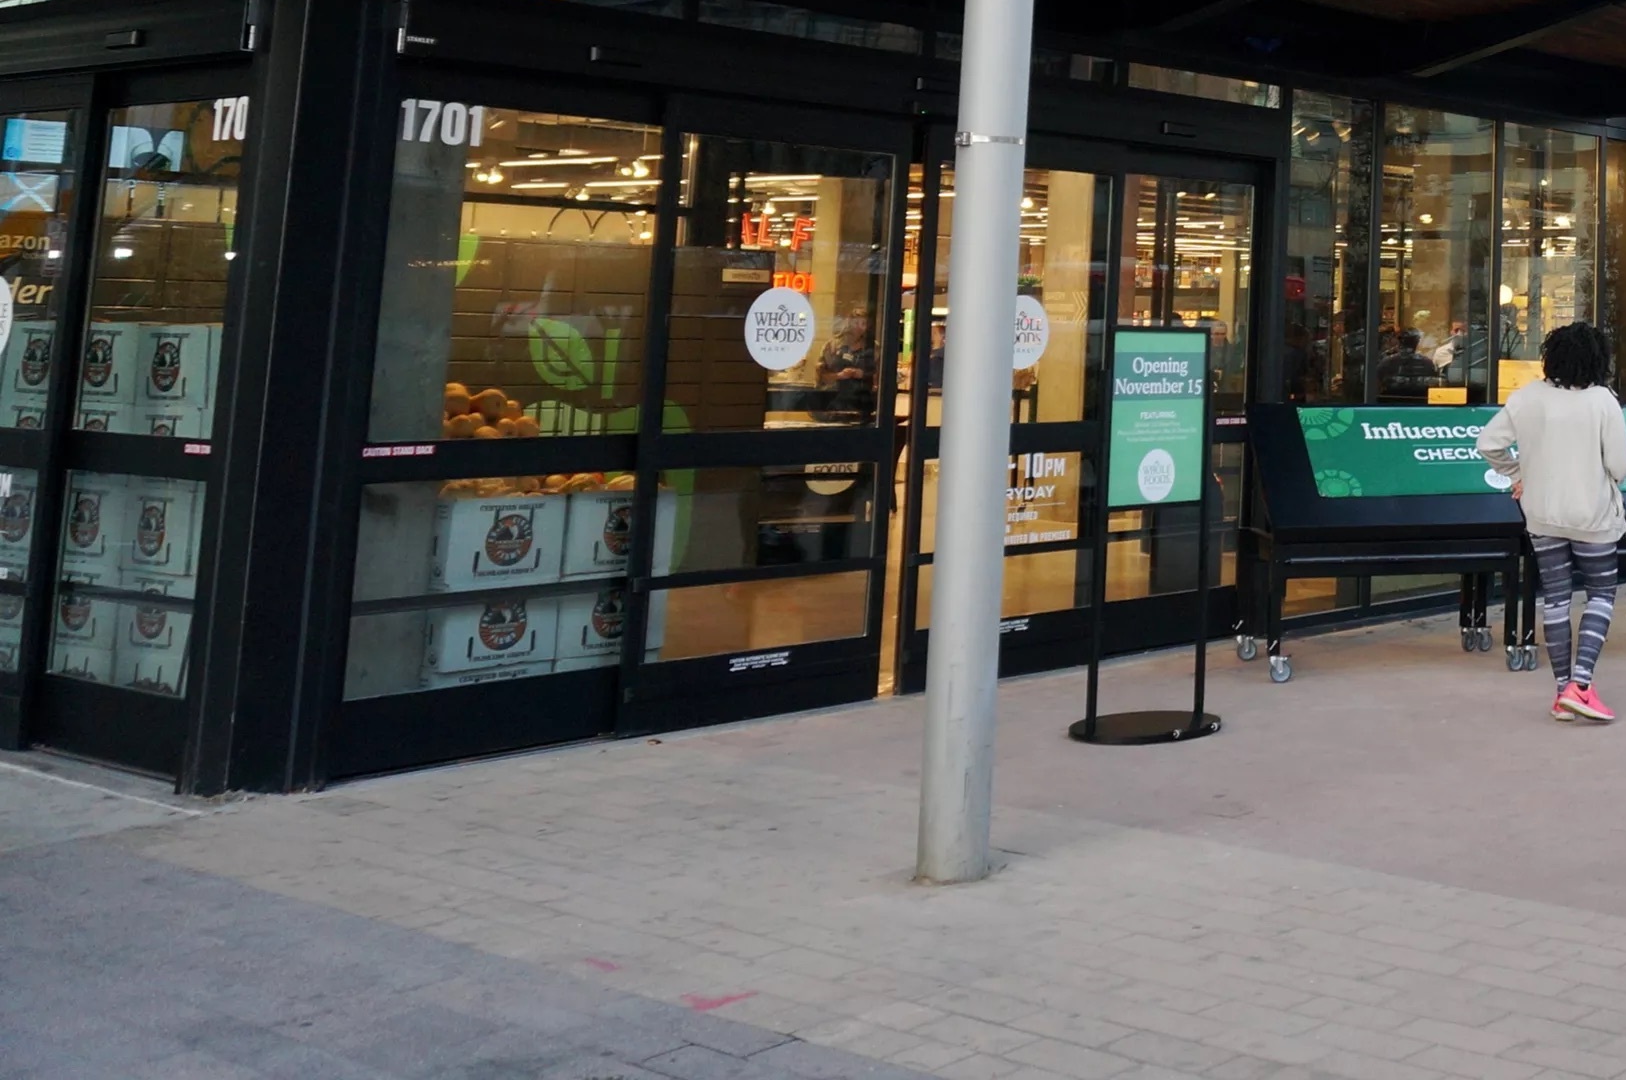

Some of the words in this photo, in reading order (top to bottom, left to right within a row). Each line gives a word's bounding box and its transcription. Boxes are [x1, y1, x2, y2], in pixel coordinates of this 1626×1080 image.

[401, 98, 484, 147] 1701
[754, 311, 808, 327] WHOLE
[755, 327, 806, 343] FOODS
[1132, 357, 1189, 377] Opening
[1114, 377, 1184, 395] November
[1187, 378, 1203, 396] 15
